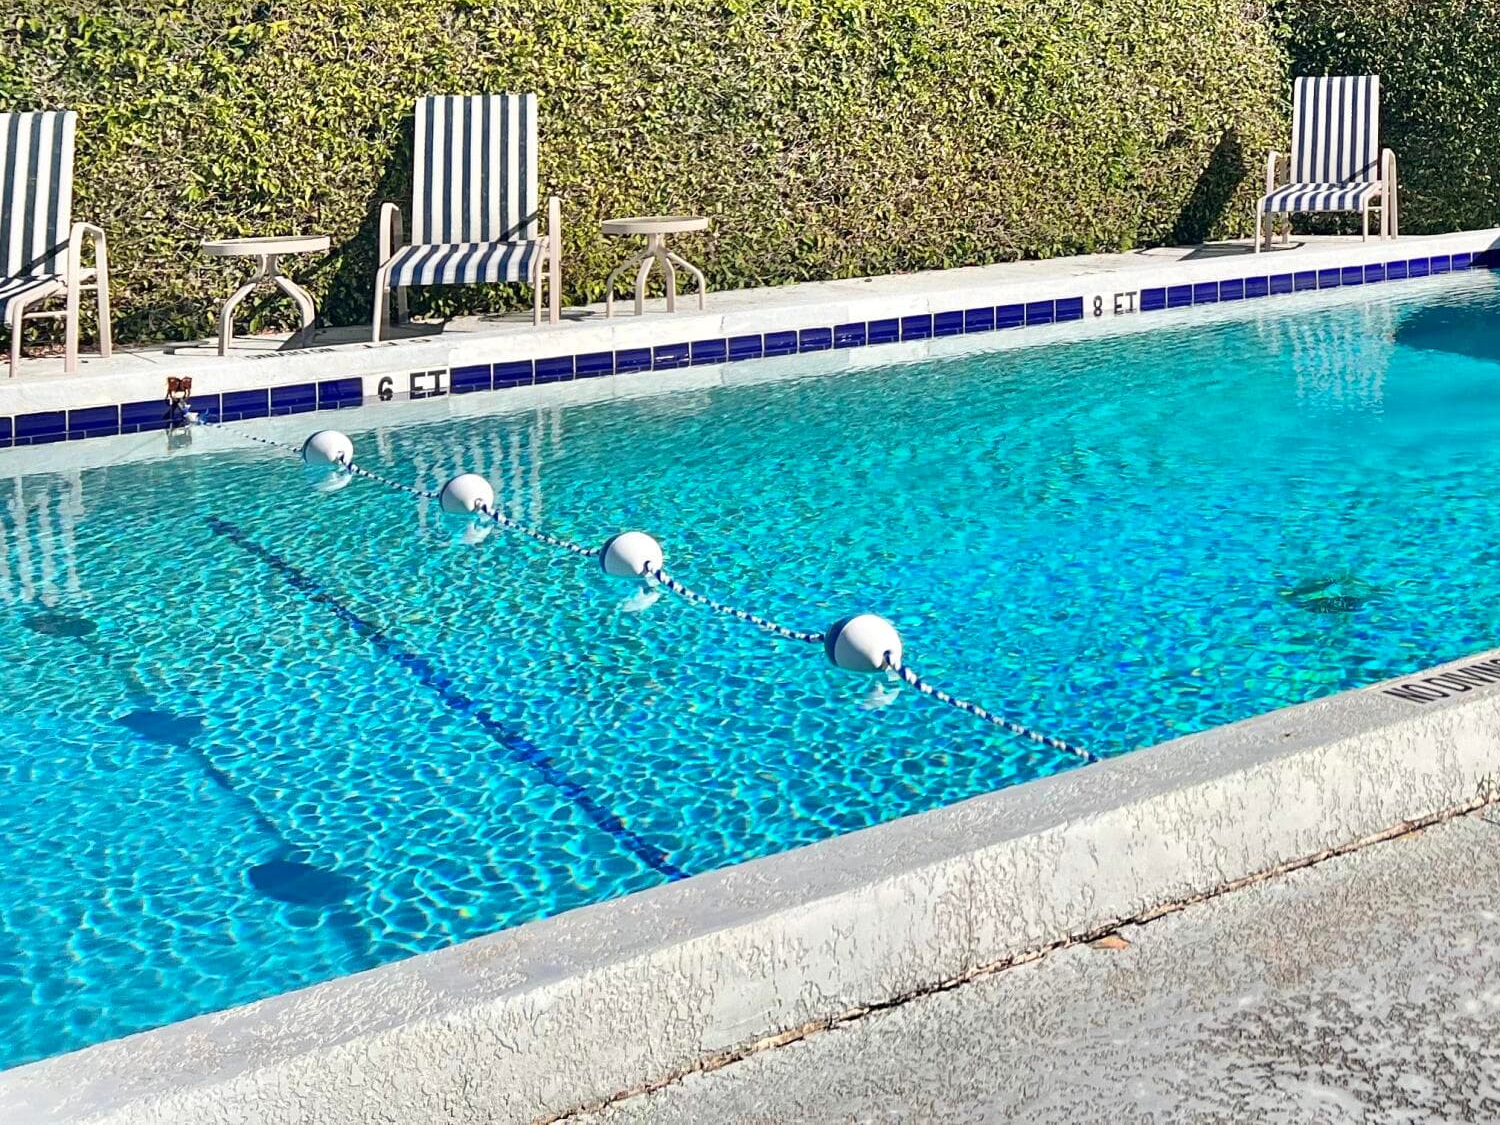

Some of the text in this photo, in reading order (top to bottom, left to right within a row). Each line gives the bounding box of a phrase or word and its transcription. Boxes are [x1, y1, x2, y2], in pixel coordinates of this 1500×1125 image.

[1093, 295, 1102, 316] 8
[378, 376, 393, 401] 6
[1383, 683, 1450, 704] NO
